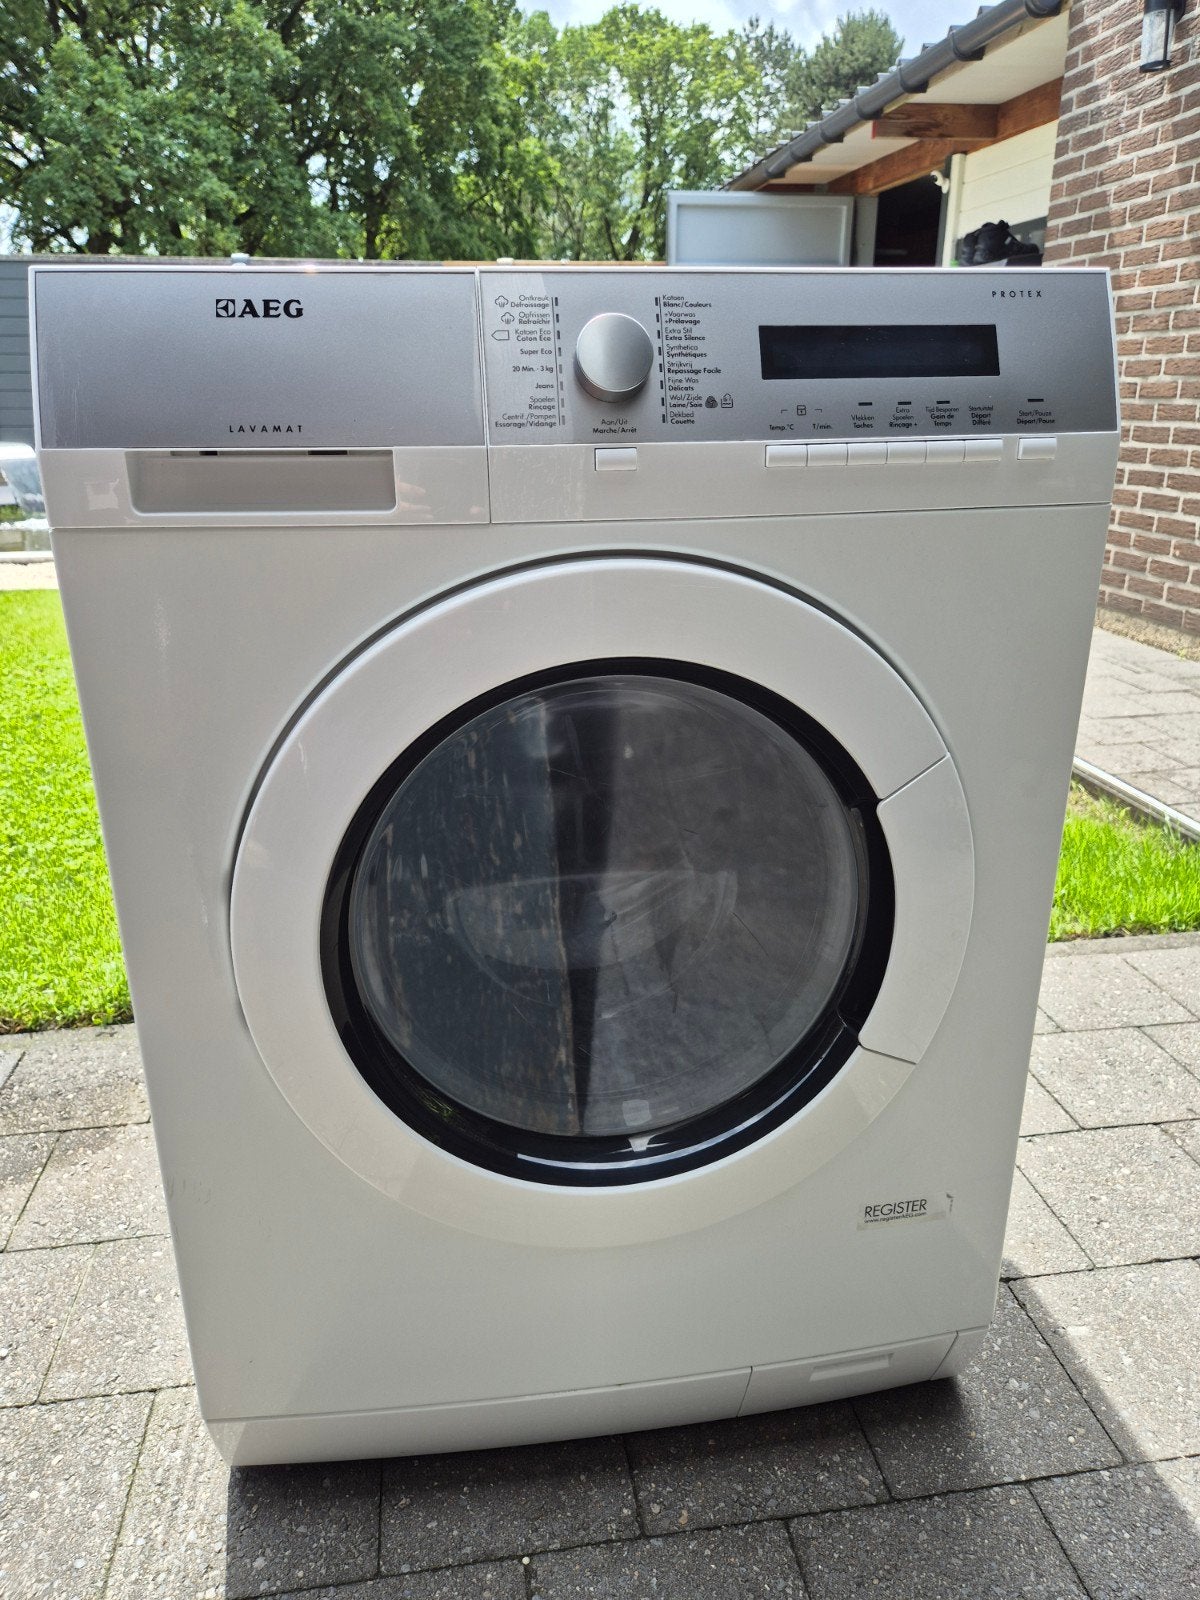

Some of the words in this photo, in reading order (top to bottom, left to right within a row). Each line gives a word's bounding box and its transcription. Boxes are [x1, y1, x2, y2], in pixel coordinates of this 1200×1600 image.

[992, 290, 1042, 298] PROTEX
[238, 299, 303, 318] AEG
[520, 348, 538, 356] Super
[530, 396, 555, 404] Spoelen
[669, 394, 702, 402] Wol/Zijde
[229, 425, 302, 433] LAVAMAT
[865, 1199, 927, 1218] REGISTER
